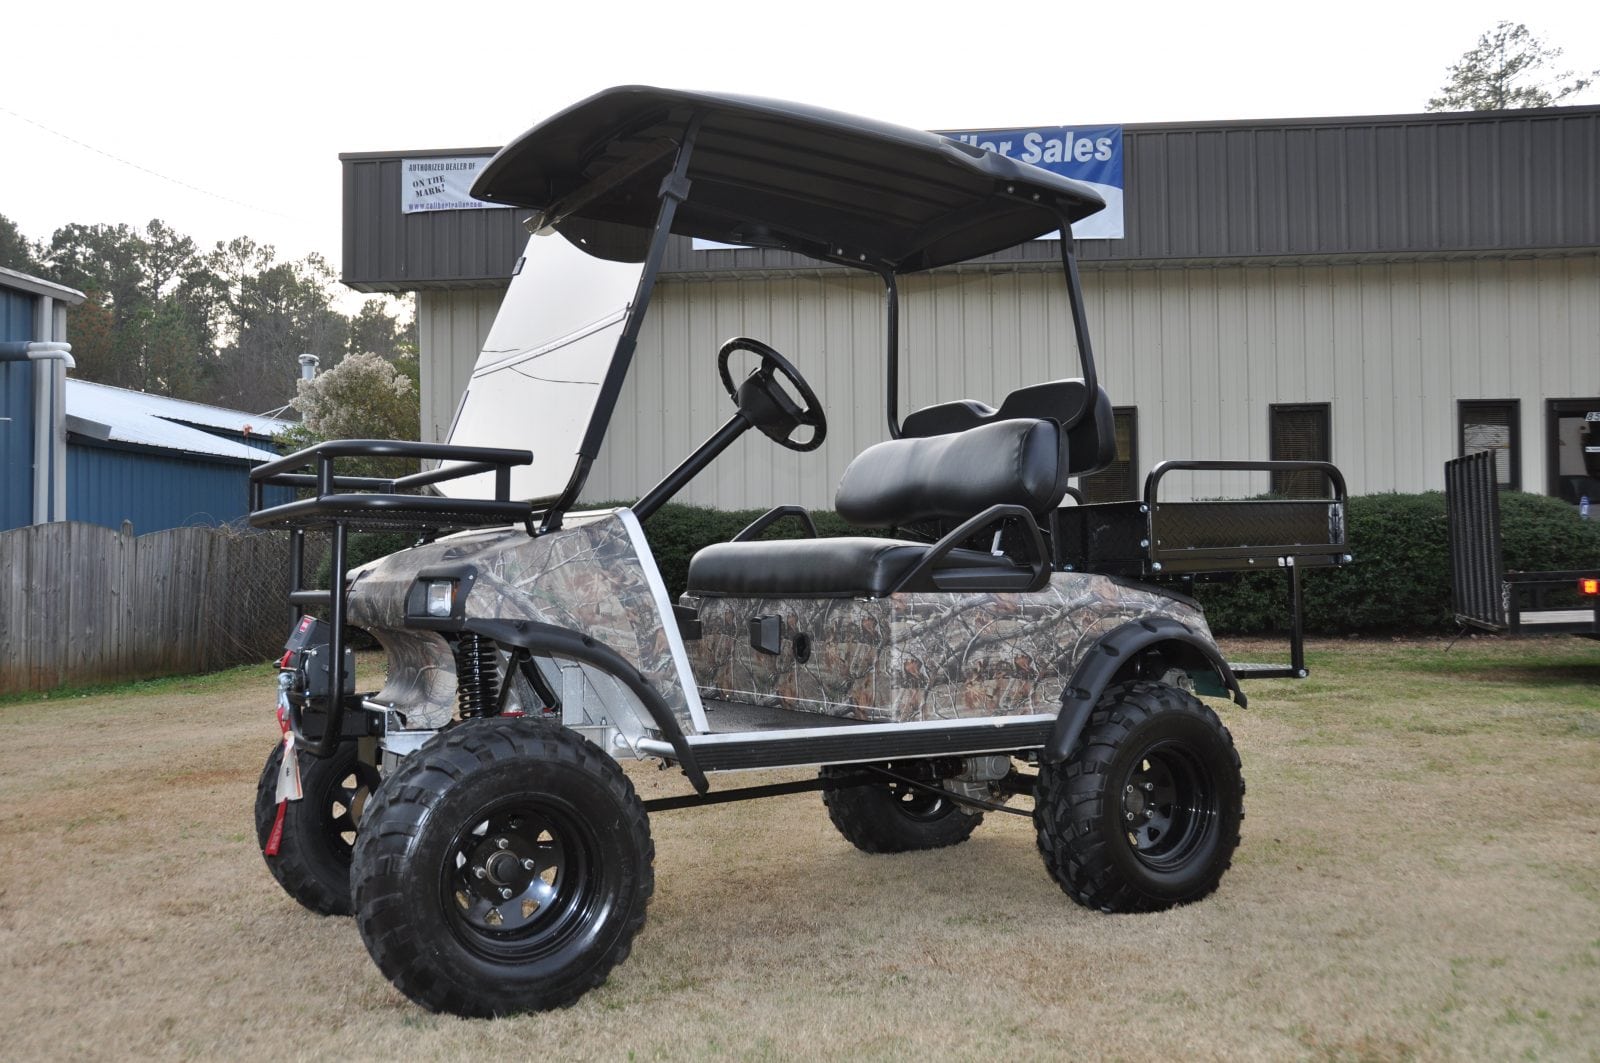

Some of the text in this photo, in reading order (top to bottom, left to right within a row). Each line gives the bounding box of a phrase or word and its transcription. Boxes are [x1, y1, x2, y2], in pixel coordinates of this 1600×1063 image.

[1021, 131, 1113, 165] Sales
[408, 162, 444, 172] AUTHORIZED
[446, 162, 468, 170] DEALER
[412, 175, 445, 188] ON THE
[416, 184, 445, 198] MARK!
